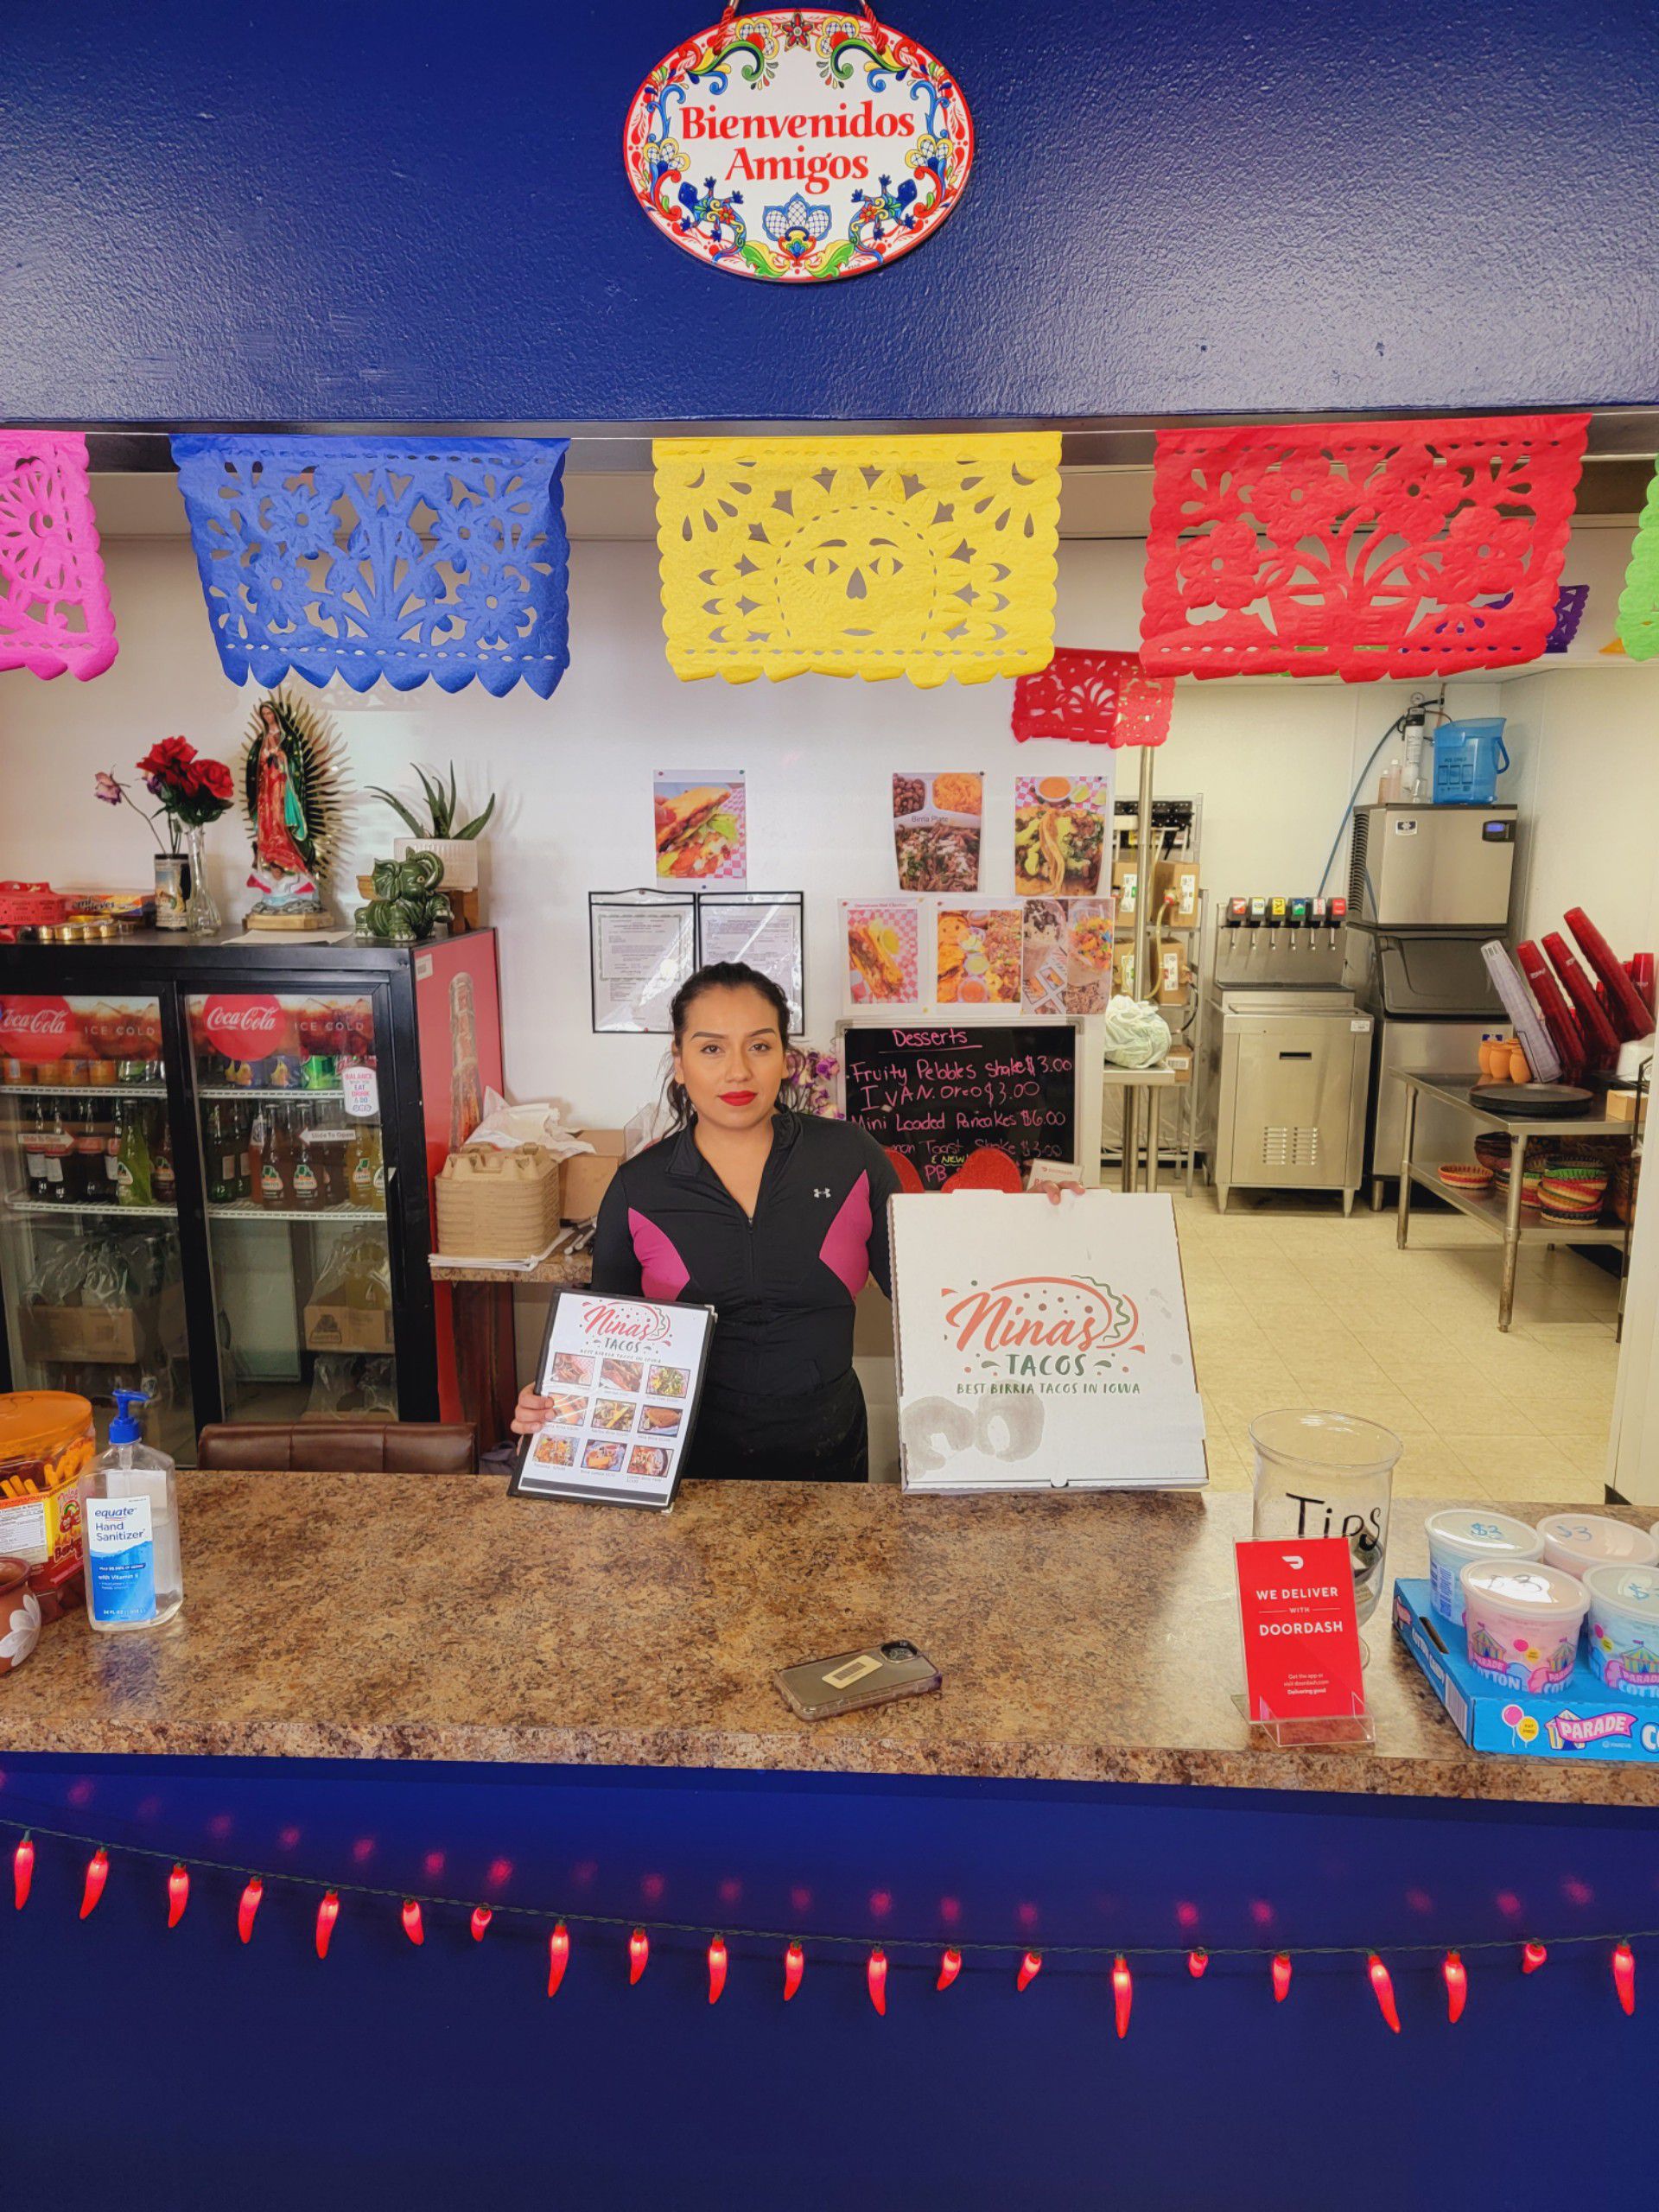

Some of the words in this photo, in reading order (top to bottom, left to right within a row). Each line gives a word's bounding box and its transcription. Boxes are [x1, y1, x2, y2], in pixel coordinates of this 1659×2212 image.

[679, 99, 916, 140] Bienvenidos
[724, 144, 869, 194] Amigos
[207, 1006, 279, 1031] Coca-Cola
[294, 1021, 318, 1032] ICE
[325, 1020, 364, 1032] COLD
[85, 1026, 108, 1036] ICE
[116, 1026, 156, 1037] COLD
[892, 1027, 969, 1048] Desserts
[849, 1060, 908, 1085] Fruity
[917, 1058, 976, 1080] Pebbles
[940, 1085, 982, 1100] Oreo
[851, 1114, 887, 1131] Mini
[896, 1112, 946, 1132] Loaded
[918, 1139, 965, 1156] Toast
[925, 1164, 948, 1183] PB
[583, 1305, 651, 1341] Ninas
[944, 1291, 1097, 1352] Ninas
[605, 1338, 642, 1353] TACOS
[1005, 1353, 1088, 1376] TACOS
[957, 1383, 987, 1395] BEST
[990, 1382, 1035, 1395] BIRRIA
[1039, 1382, 1077, 1395] TACOS
[1084, 1383, 1098, 1395] IN
[1103, 1383, 1141, 1395] IOWA
[94, 1507, 135, 1520] equate
[1285, 1492, 1382, 1552] Tips
[95, 1521, 124, 1531] Hand
[96, 1530, 144, 1541] Sanitizer
[1470, 1522, 1503, 1540] $3
[1255, 1589, 1278, 1601] WE
[1281, 1586, 1338, 1599] DELIVER
[1259, 1620, 1344, 1637] DOORDASH
[1560, 1715, 1627, 1739] PARADE
[1641, 1724, 1659, 1751] C
